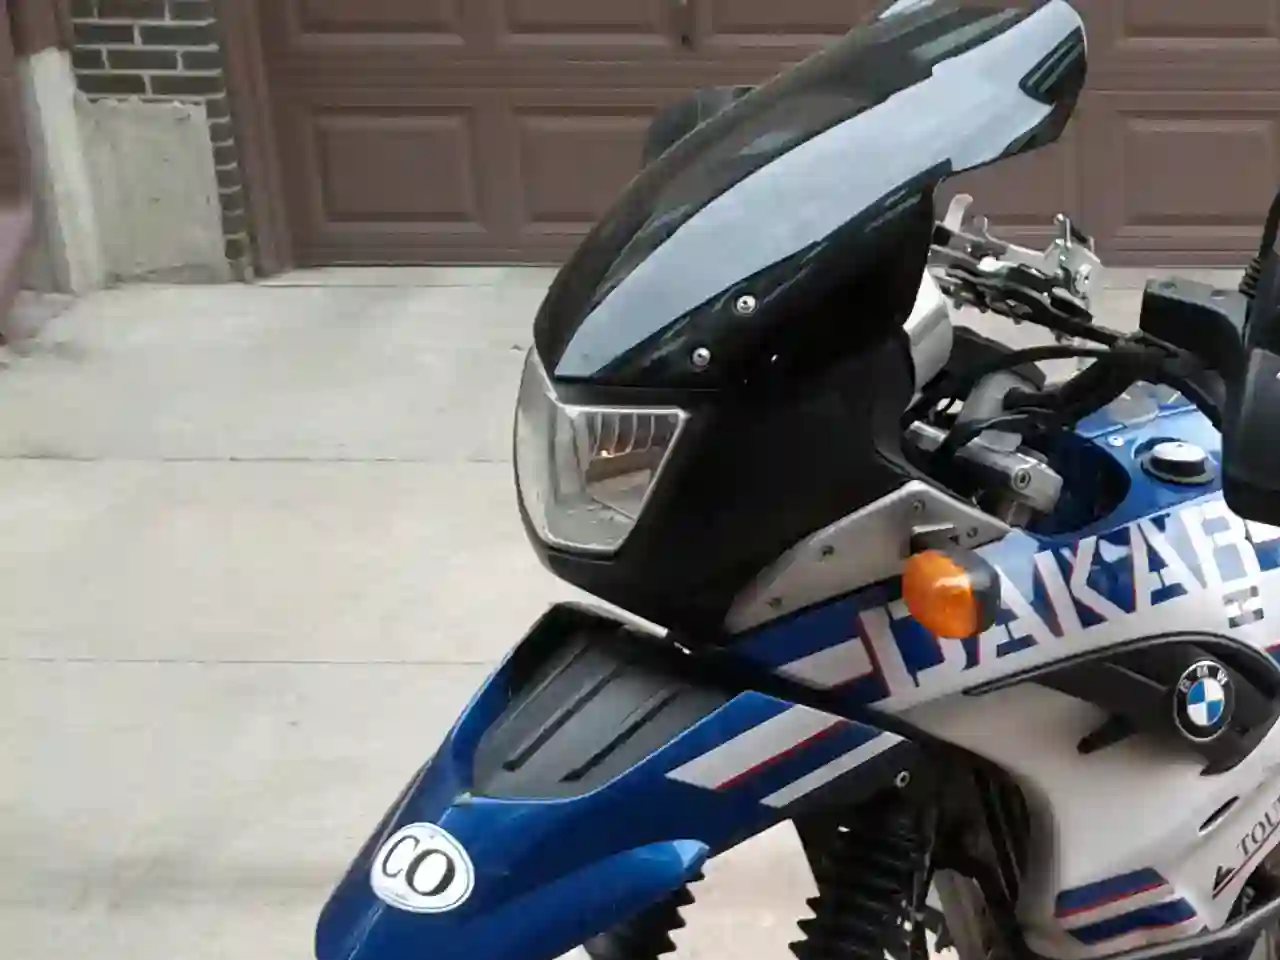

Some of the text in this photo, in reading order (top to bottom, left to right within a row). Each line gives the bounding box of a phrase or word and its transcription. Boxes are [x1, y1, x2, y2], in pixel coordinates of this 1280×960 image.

[858, 499, 1264, 706] DAKAR
[1179, 664, 1228, 693] BMW
[382, 835, 456, 896] CO
